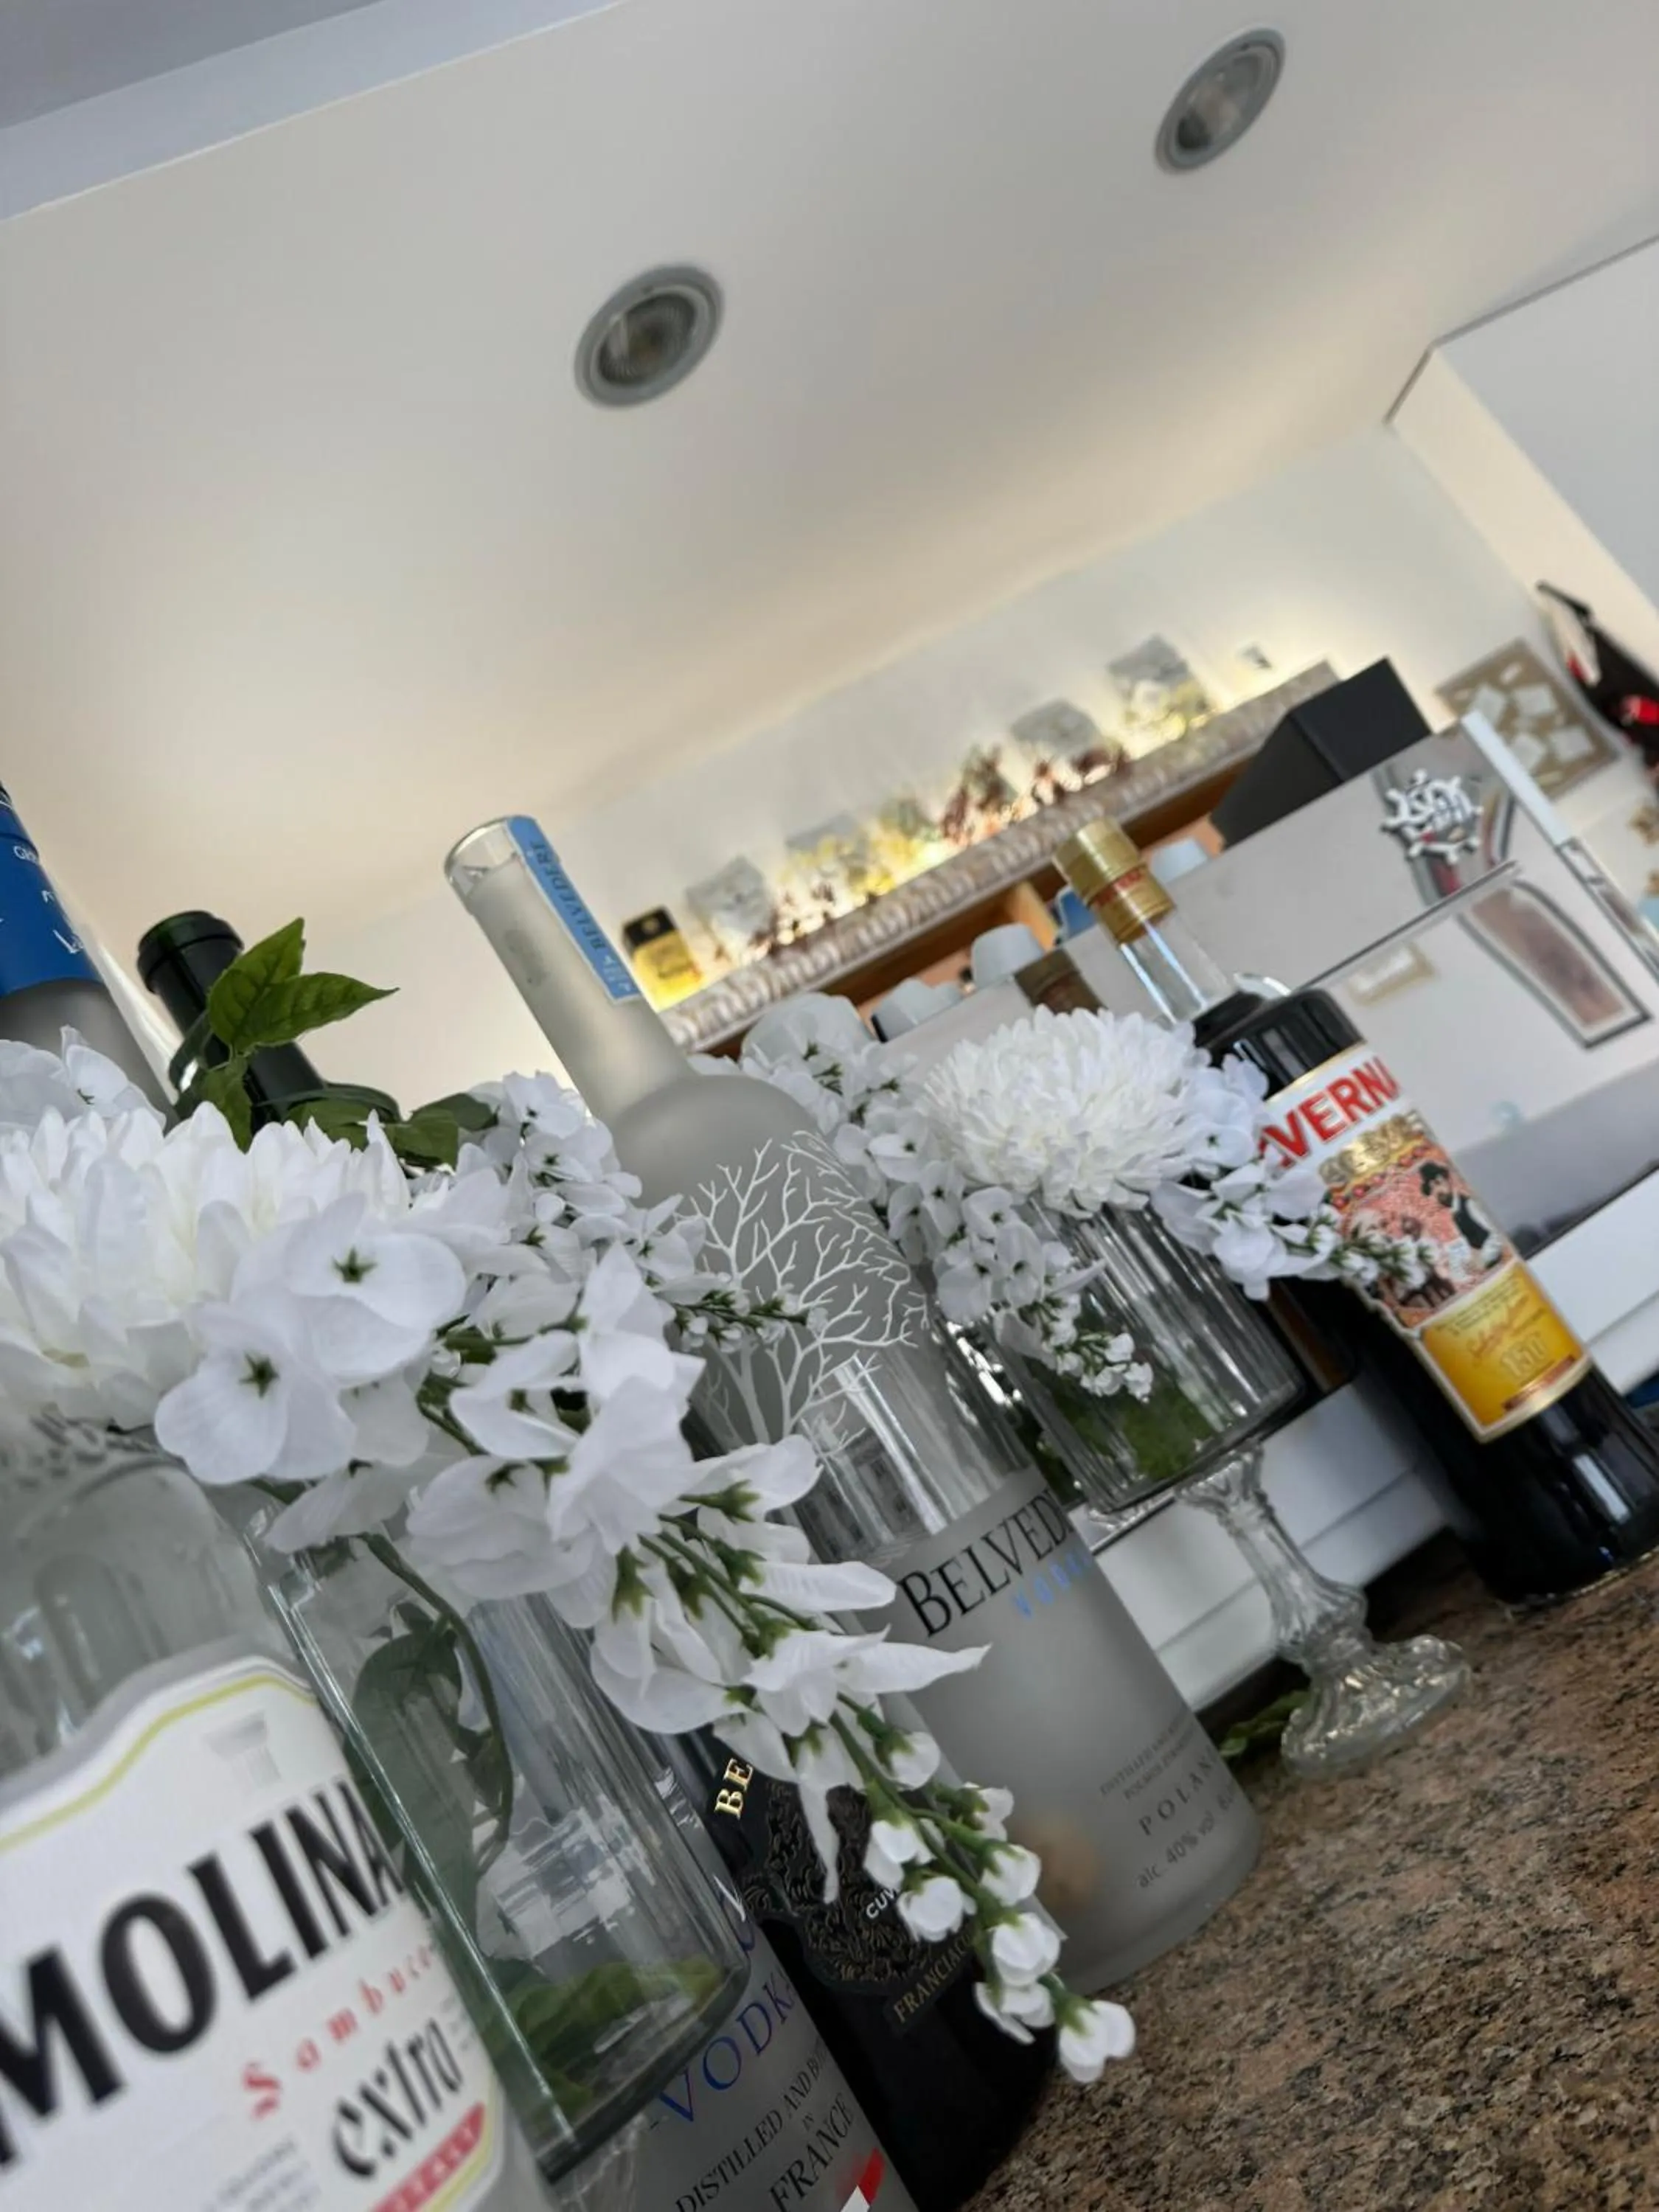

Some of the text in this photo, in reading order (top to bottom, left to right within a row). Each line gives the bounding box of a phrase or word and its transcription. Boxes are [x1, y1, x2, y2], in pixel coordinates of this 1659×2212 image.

[897, 1489, 1074, 1638] BELVED
[331, 2019, 465, 2179] extra
[675, 2109, 784, 2212] DISTILLED
[768, 2091, 855, 2212] FRANCE
